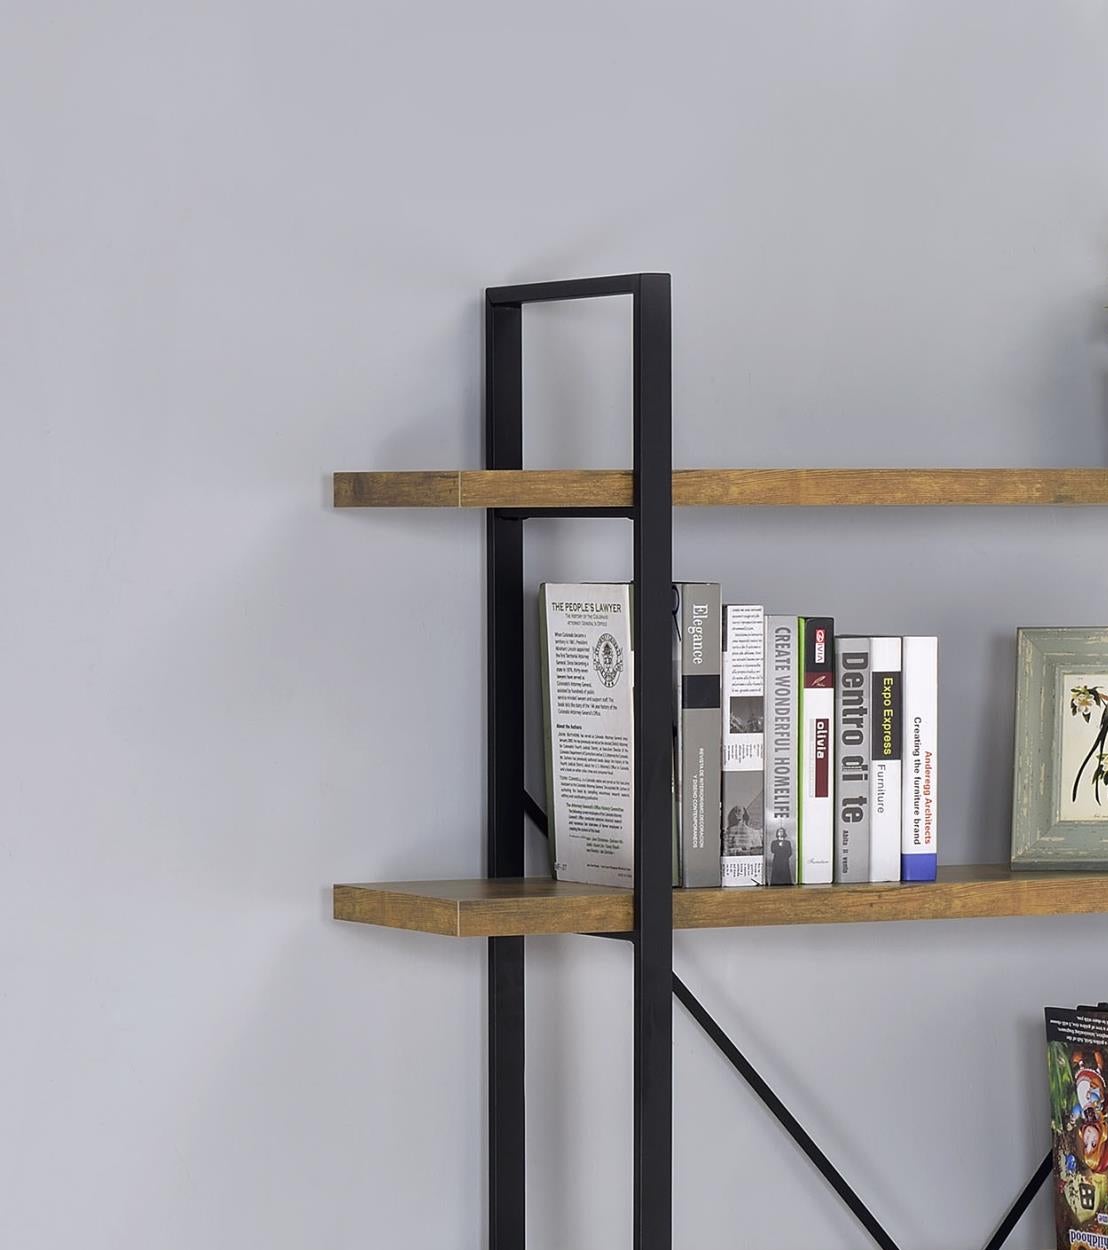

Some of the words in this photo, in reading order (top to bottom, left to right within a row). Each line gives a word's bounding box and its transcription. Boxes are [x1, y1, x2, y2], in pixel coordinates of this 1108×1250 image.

[551, 602, 564, 611] THE
[565, 602, 594, 612] PEOPLE'S
[595, 603, 622, 613] LAWYER
[687, 604, 708, 664] Elegance
[774, 627, 791, 671] CREATE
[842, 653, 869, 745] Dentro
[882, 678, 894, 706] Expo
[774, 676, 791, 752] WONDERFUL
[882, 709, 894, 755] Express
[816, 721, 828, 759] olivia
[912, 717, 922, 756] Creating
[842, 756, 869, 781] di
[913, 759, 921, 774] the
[774, 758, 790, 818] HOMELIFE
[877, 764, 886, 814] Furniture
[913, 776, 921, 816] furniture
[842, 796, 868, 823] te
[924, 799, 933, 844] Architects
[913, 819, 921, 845] brand
